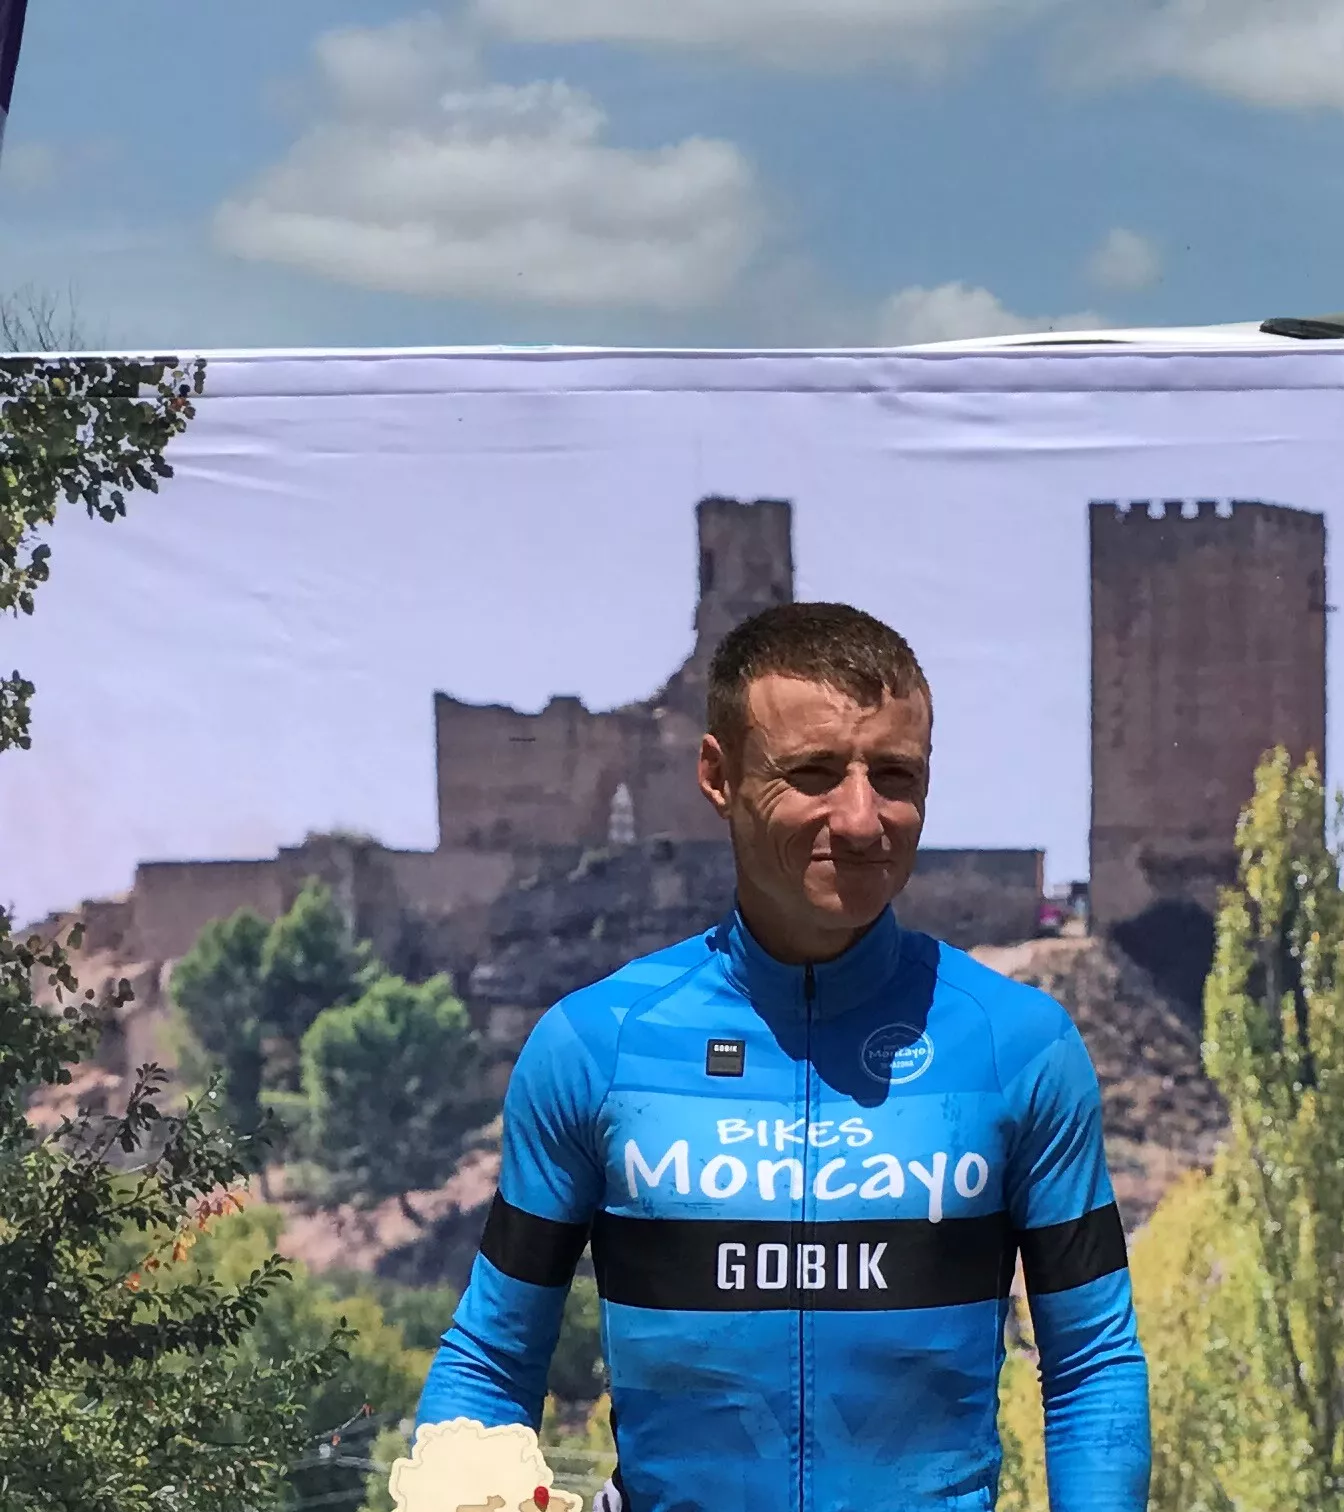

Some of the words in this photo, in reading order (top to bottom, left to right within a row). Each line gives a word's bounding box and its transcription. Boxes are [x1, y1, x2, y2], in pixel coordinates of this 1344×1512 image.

[716, 1117, 874, 1151] BIKES
[623, 1138, 989, 1224] Moncayo
[716, 1242, 889, 1291] GOBIK
